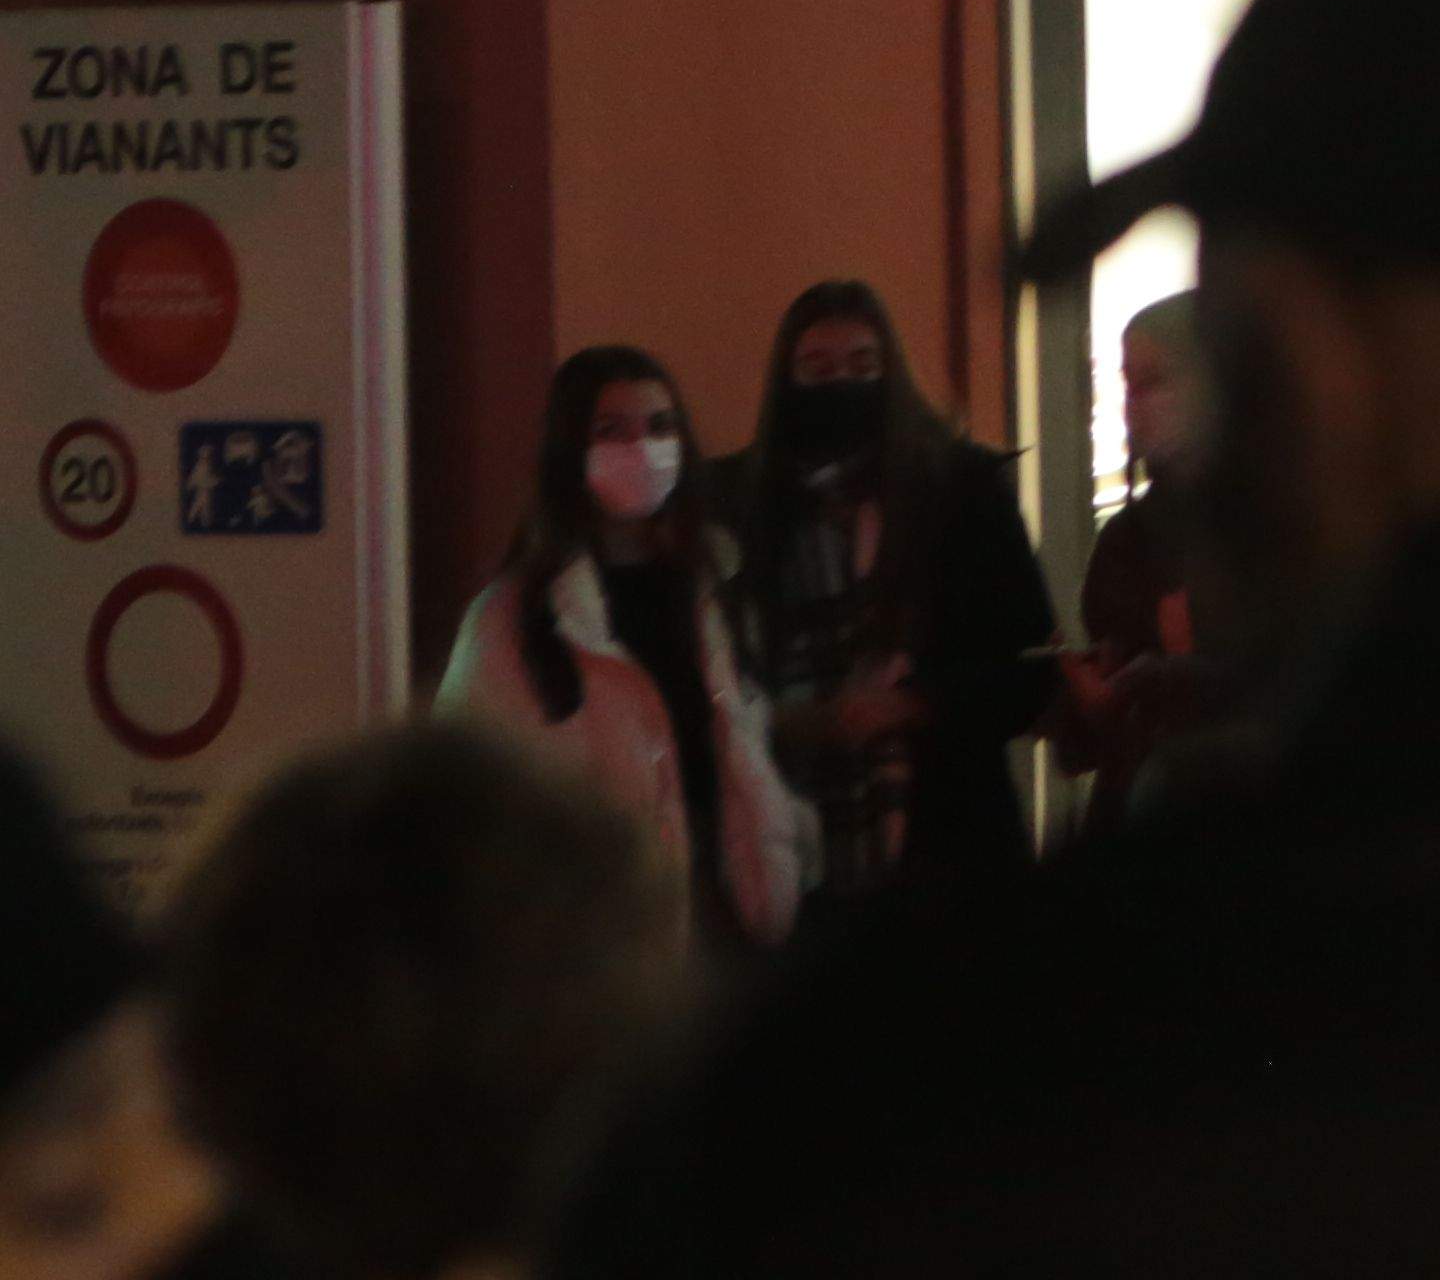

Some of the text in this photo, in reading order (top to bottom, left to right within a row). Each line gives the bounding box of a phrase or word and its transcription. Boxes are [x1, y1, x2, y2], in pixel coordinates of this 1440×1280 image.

[32, 41, 297, 100] ZONA DE
[19, 115, 299, 176] VIANANTS
[61, 456, 116, 506] 20
